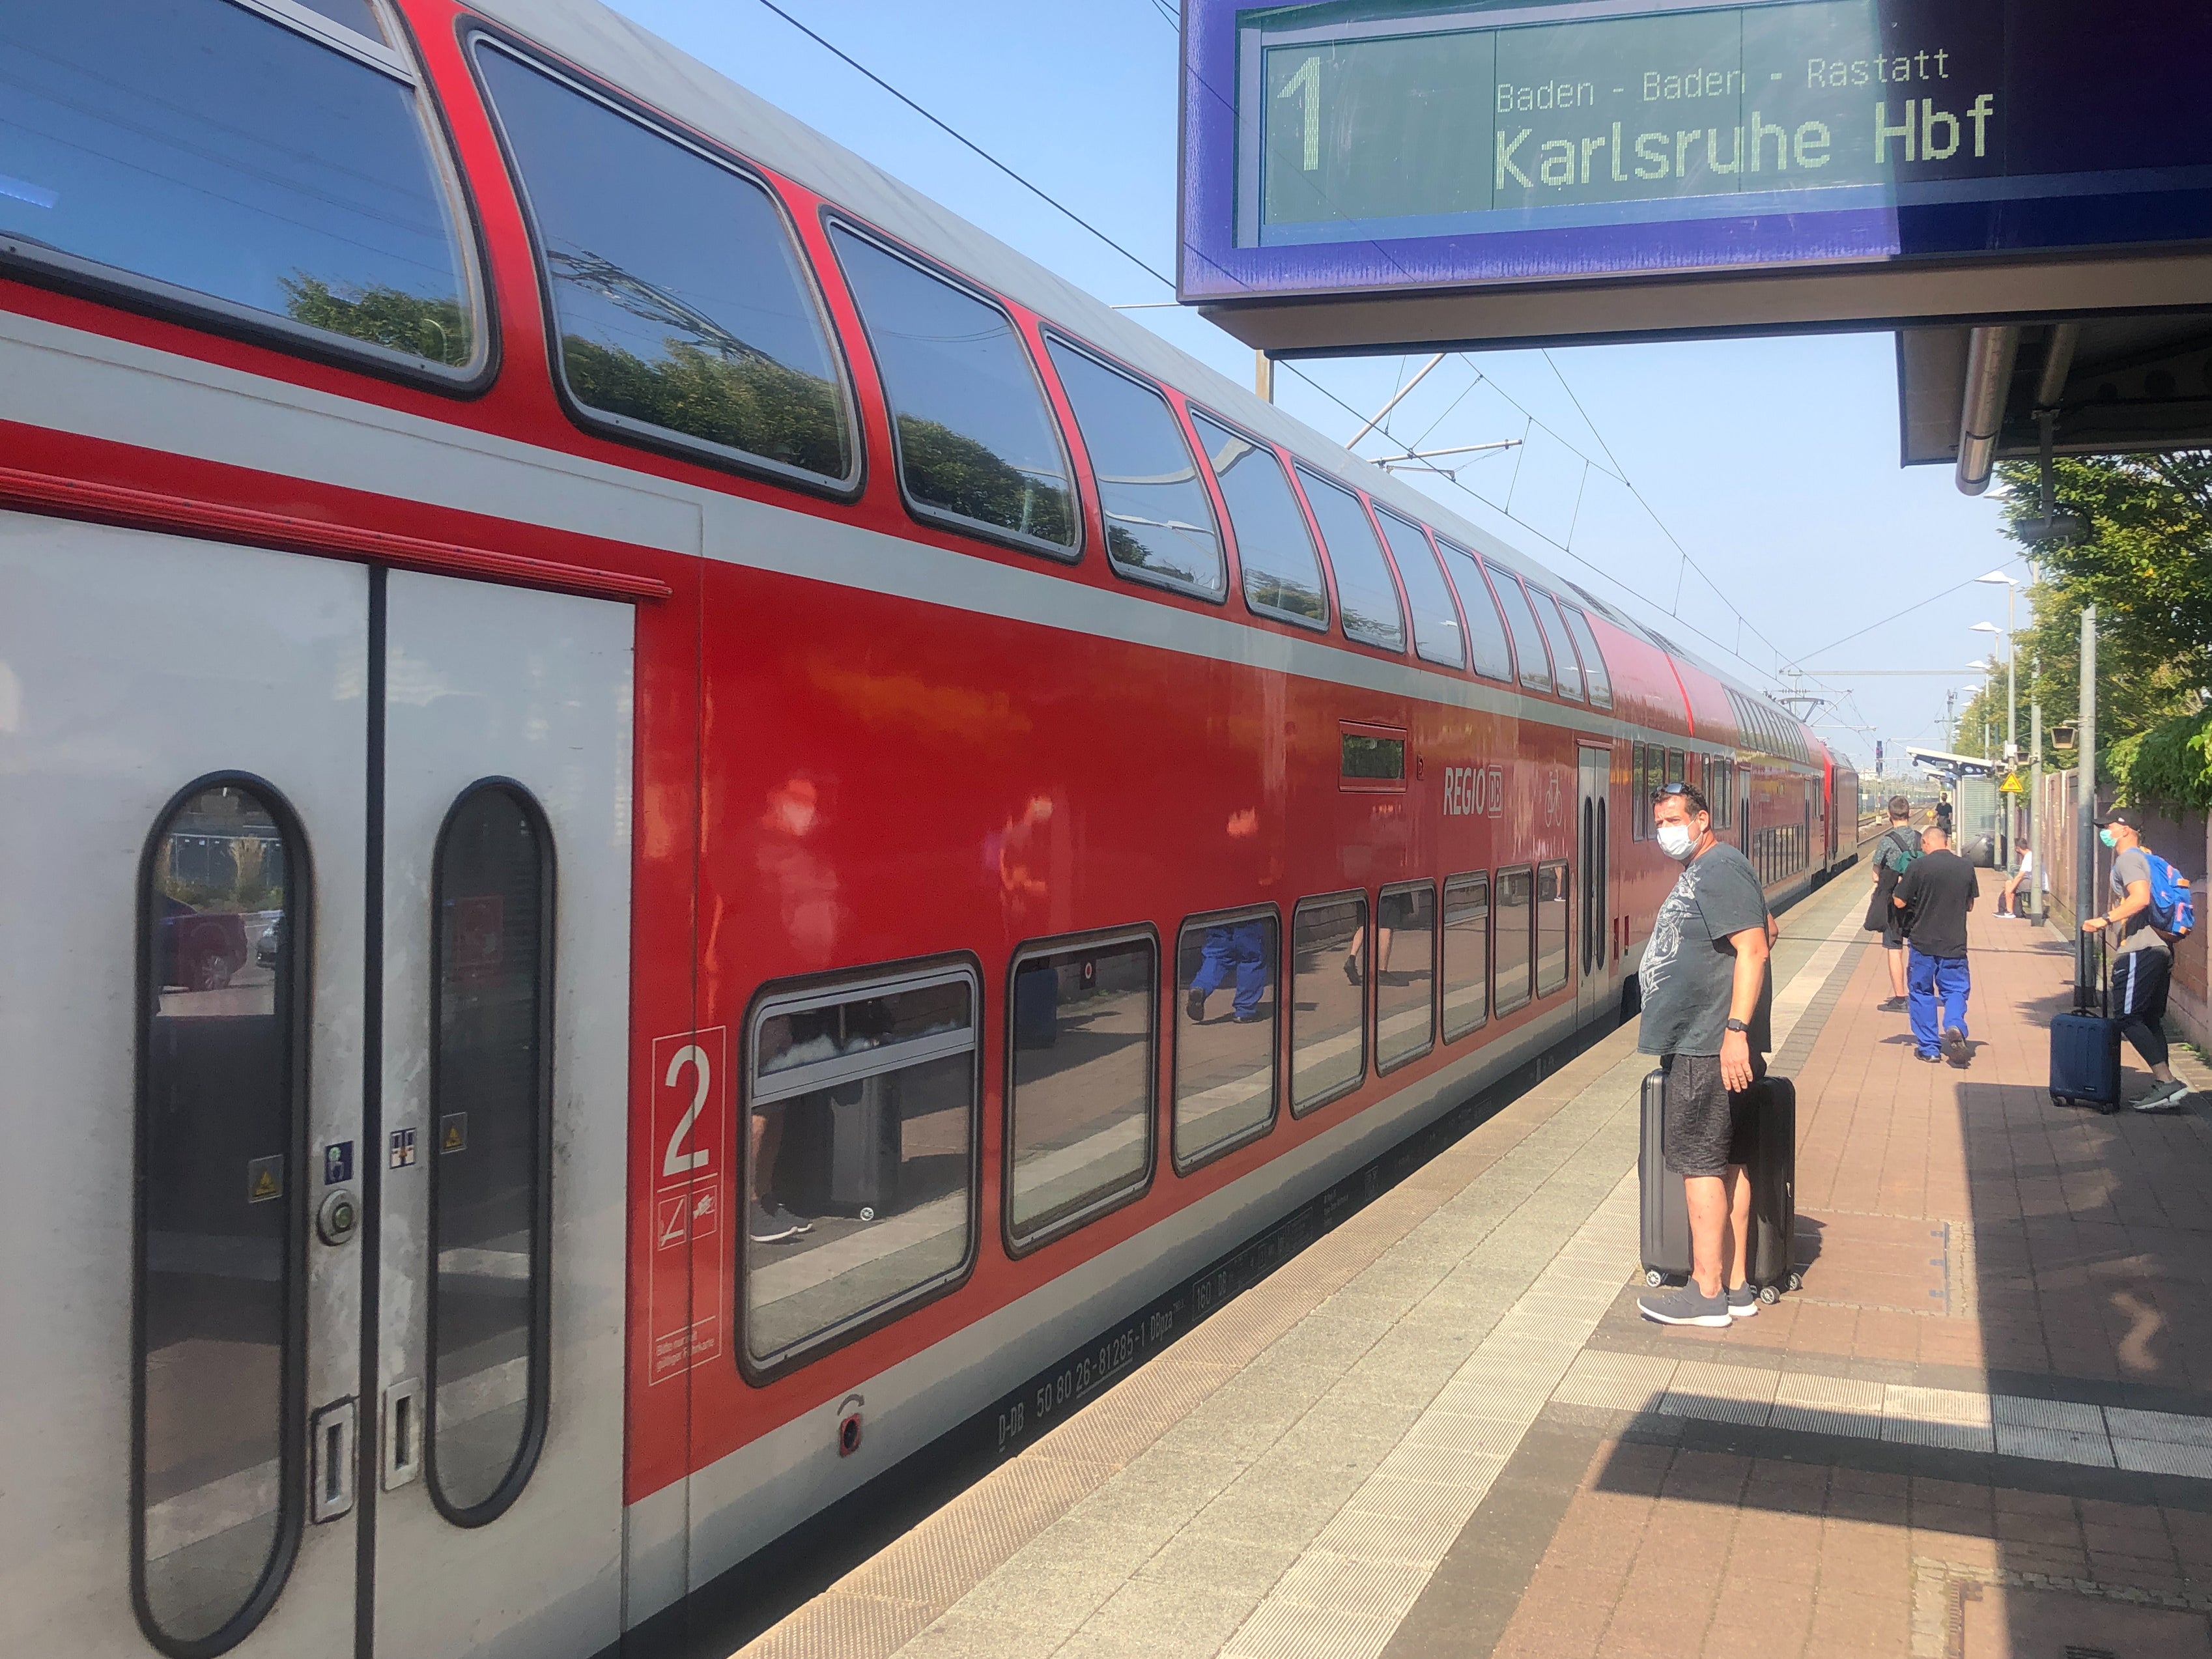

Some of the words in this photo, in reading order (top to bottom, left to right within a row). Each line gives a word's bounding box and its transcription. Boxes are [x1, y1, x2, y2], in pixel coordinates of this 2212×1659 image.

[1277, 56, 1320, 171] 1
[1497, 82, 1594, 113] Baden
[1643, 67, 1746, 102] Baden
[1808, 48, 1950, 89] Rastatt
[1496, 111, 1831, 190] Karlsruhe
[1875, 94, 1993, 164] Hbf
[1443, 767, 1485, 815] REGIO
[1488, 771, 1501, 812] DB
[662, 1045, 710, 1176] 2
[1197, 1281, 1212, 1311] 160
[999, 1402, 1024, 1445] D-DB
[1036, 1383, 1053, 1418] 50
[1056, 1370, 1071, 1404] 80
